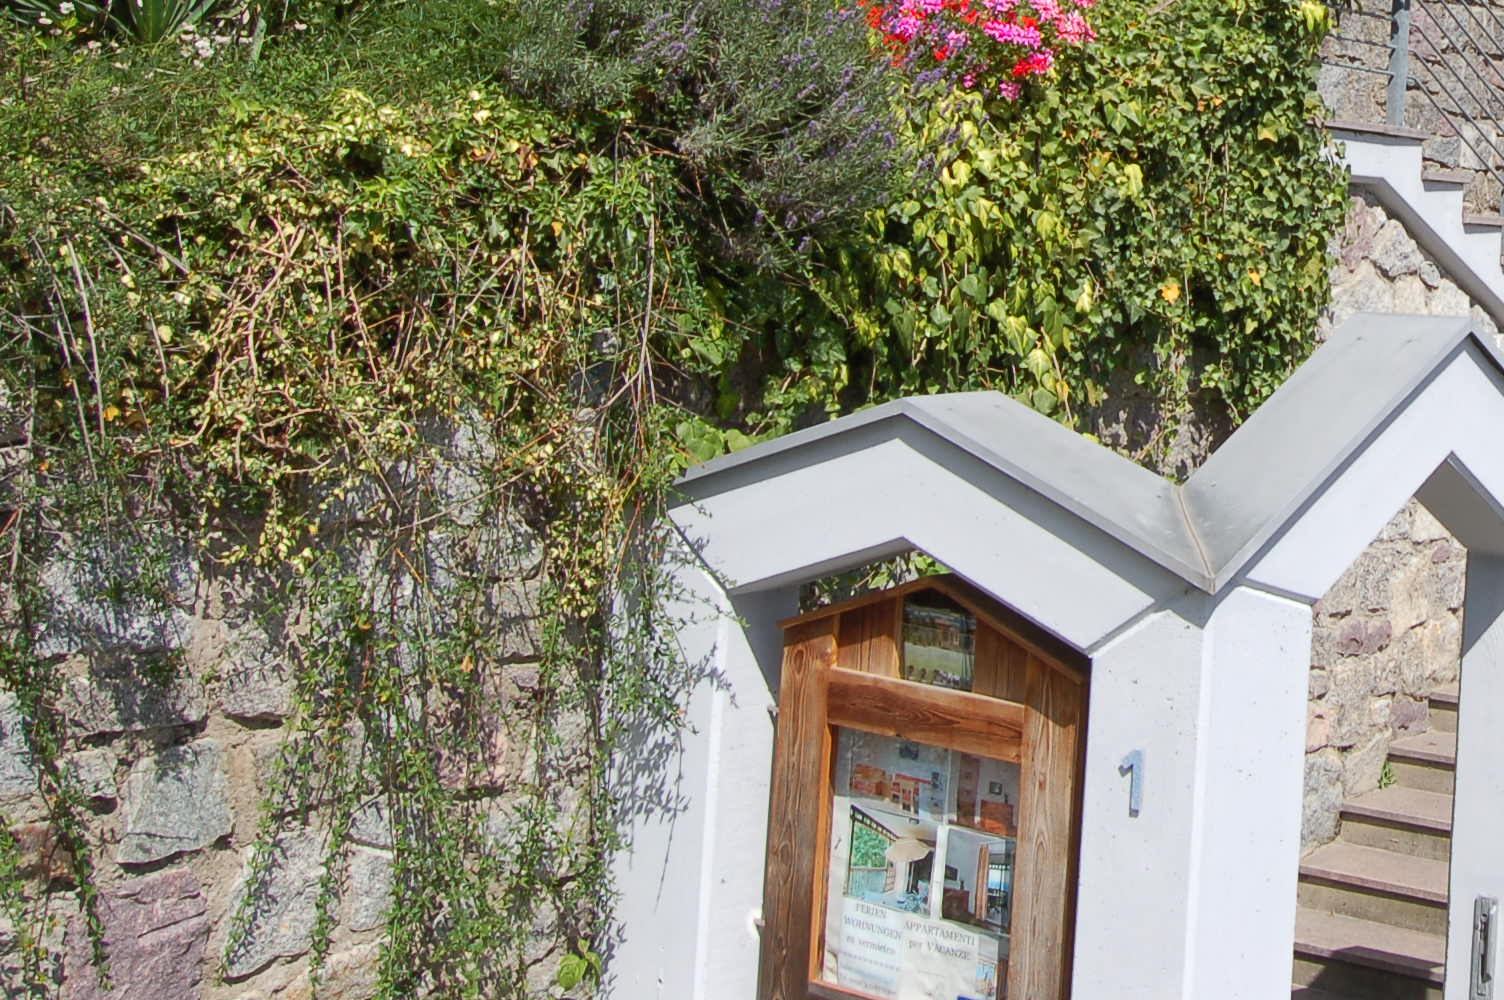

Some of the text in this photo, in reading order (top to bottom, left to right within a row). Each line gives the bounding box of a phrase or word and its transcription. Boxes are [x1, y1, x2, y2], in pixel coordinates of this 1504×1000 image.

[1118, 750, 1143, 818] 1
[843, 914, 902, 940] WOHNUNGEN
[903, 920, 976, 947] APPARTAMENTI
